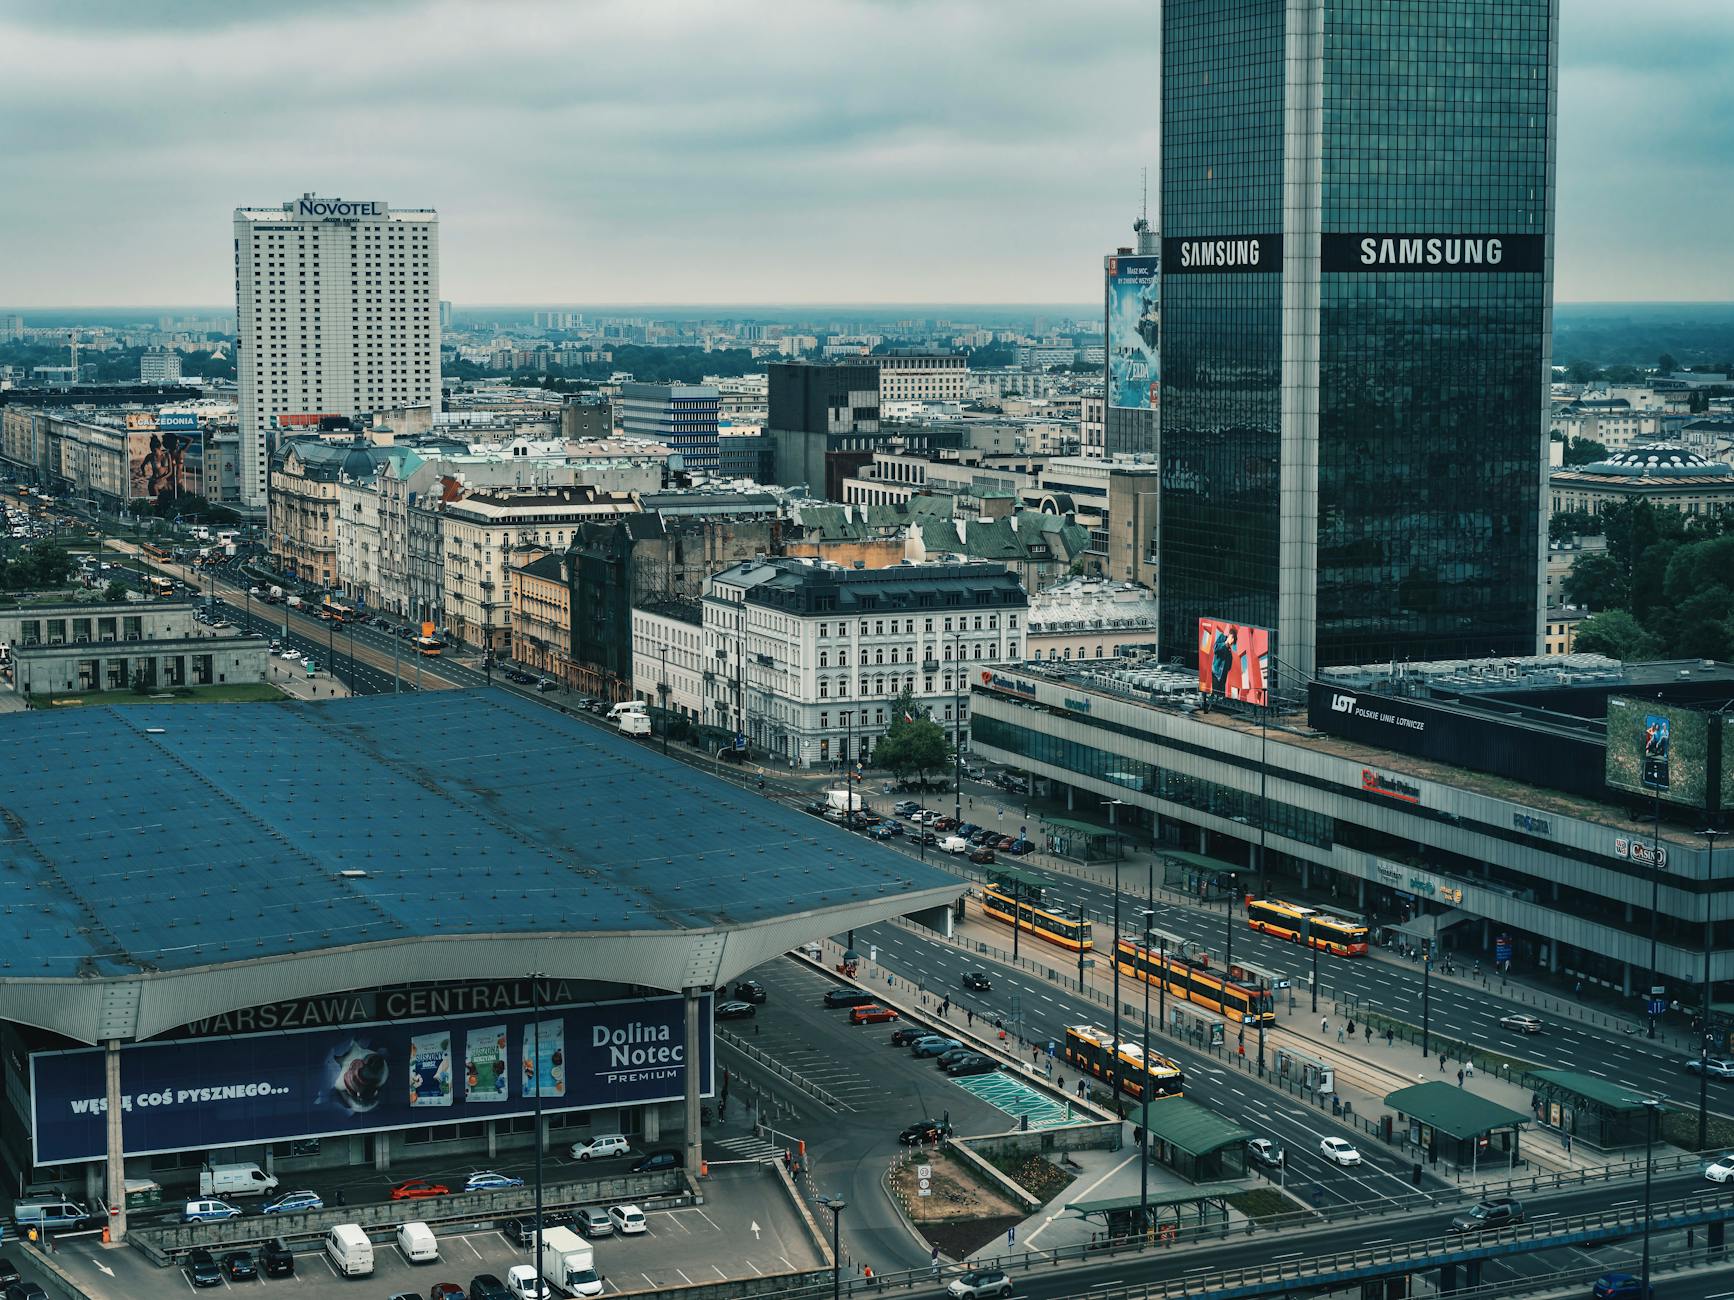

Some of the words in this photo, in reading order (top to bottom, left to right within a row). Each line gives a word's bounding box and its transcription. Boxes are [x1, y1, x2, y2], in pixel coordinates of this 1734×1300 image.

[300, 201, 382, 216] NOVOTEL
[1181, 239, 1260, 267] SAMSUNG
[1360, 237, 1502, 265] SAMSUNG
[138, 417, 194, 426] CALZEDONIA
[1331, 694, 1356, 713] LOT
[1354, 707, 1379, 720] POLSKIE
[1379, 713, 1396, 724] LINIE
[1396, 716, 1425, 731] LOTNICZE
[187, 997, 368, 1034] WARSZAWA
[387, 980, 573, 1016] CENTRALNA
[592, 1022, 670, 1047] Dolina
[608, 1045, 684, 1068] Notec
[607, 1070, 677, 1084] PREMIUM
[71, 1095, 132, 1115] WĘSĘ
[136, 1088, 174, 1107] COŚ
[178, 1082, 289, 1104] PYSZNEGO...
